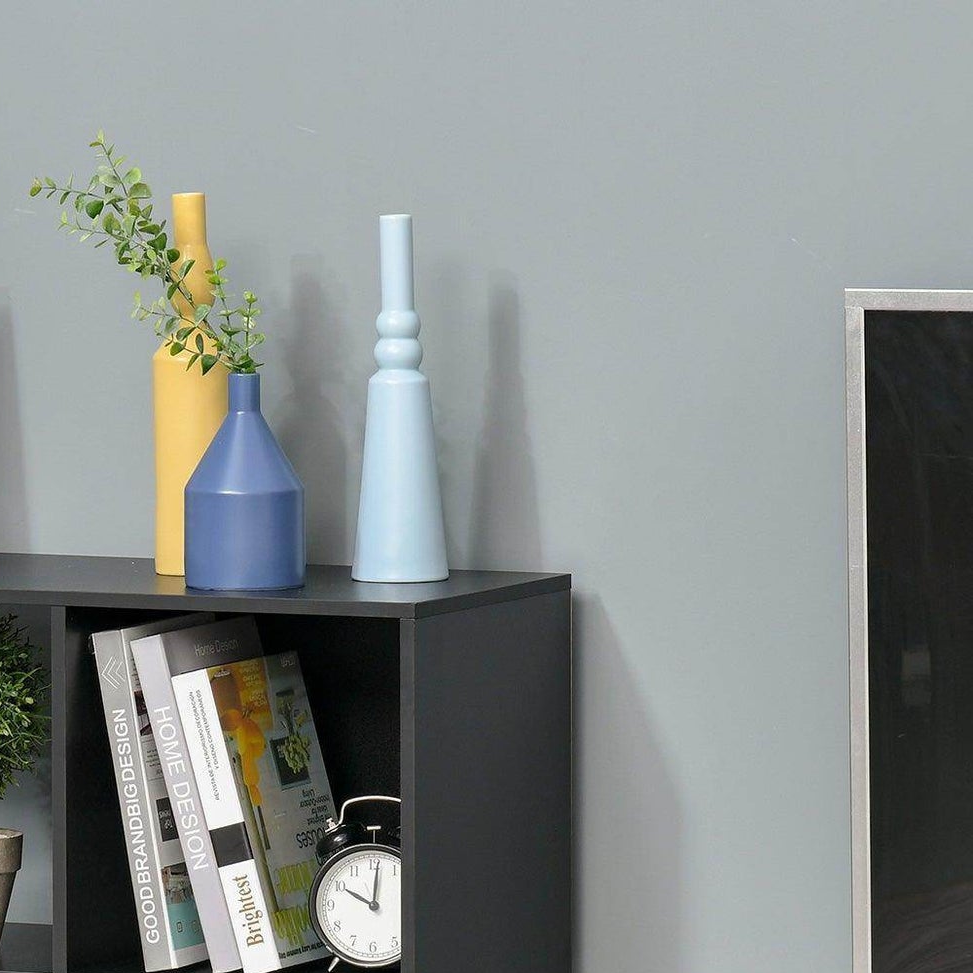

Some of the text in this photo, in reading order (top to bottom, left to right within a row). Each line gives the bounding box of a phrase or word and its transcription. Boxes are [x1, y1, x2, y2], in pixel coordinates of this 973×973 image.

[154, 705, 186, 777] HOME
[295, 827, 327, 849] ouses
[349, 865, 359, 877] 11
[393, 865, 397, 876] 1
[335, 880, 346, 892] 10
[236, 874, 264, 947] Brightest
[327, 899, 335, 911] 9
[334, 920, 342, 933] 8
[349, 935, 357, 947] 7
[369, 941, 377, 953] 6
[391, 936, 399, 948] 5
